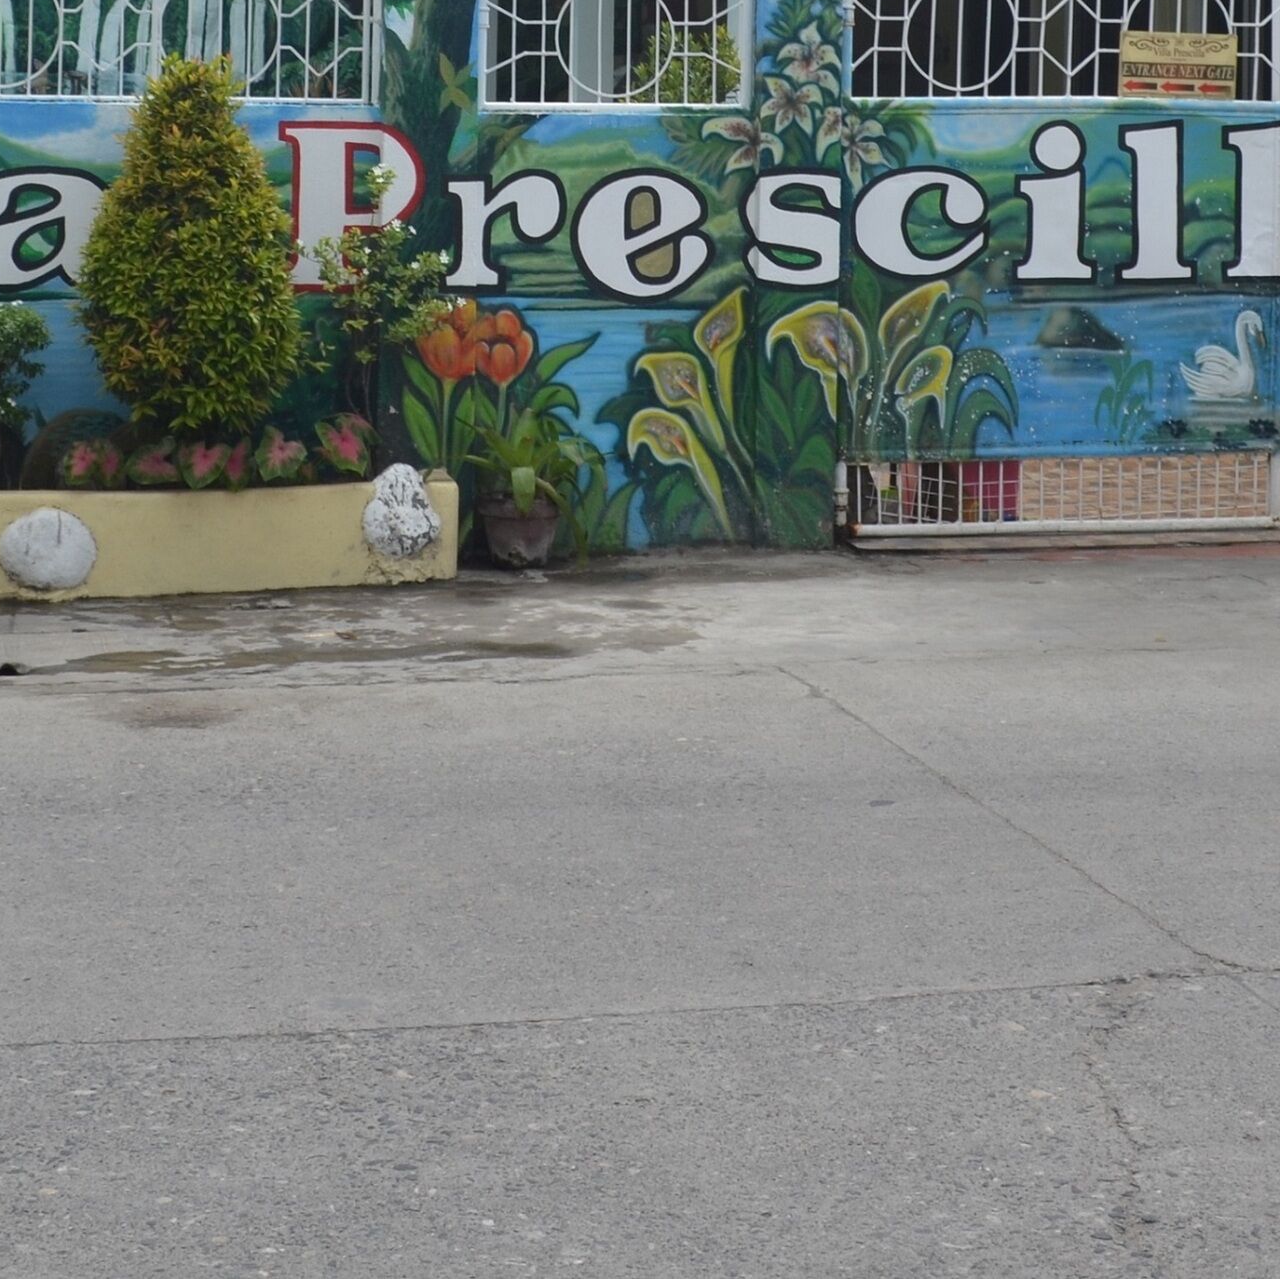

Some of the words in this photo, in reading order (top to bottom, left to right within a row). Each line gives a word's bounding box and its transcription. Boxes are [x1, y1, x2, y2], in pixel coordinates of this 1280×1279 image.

[1122, 63, 1177, 77] ENTRANCE
[1178, 65, 1206, 79] NEXT
[1207, 66, 1234, 80] GATE
